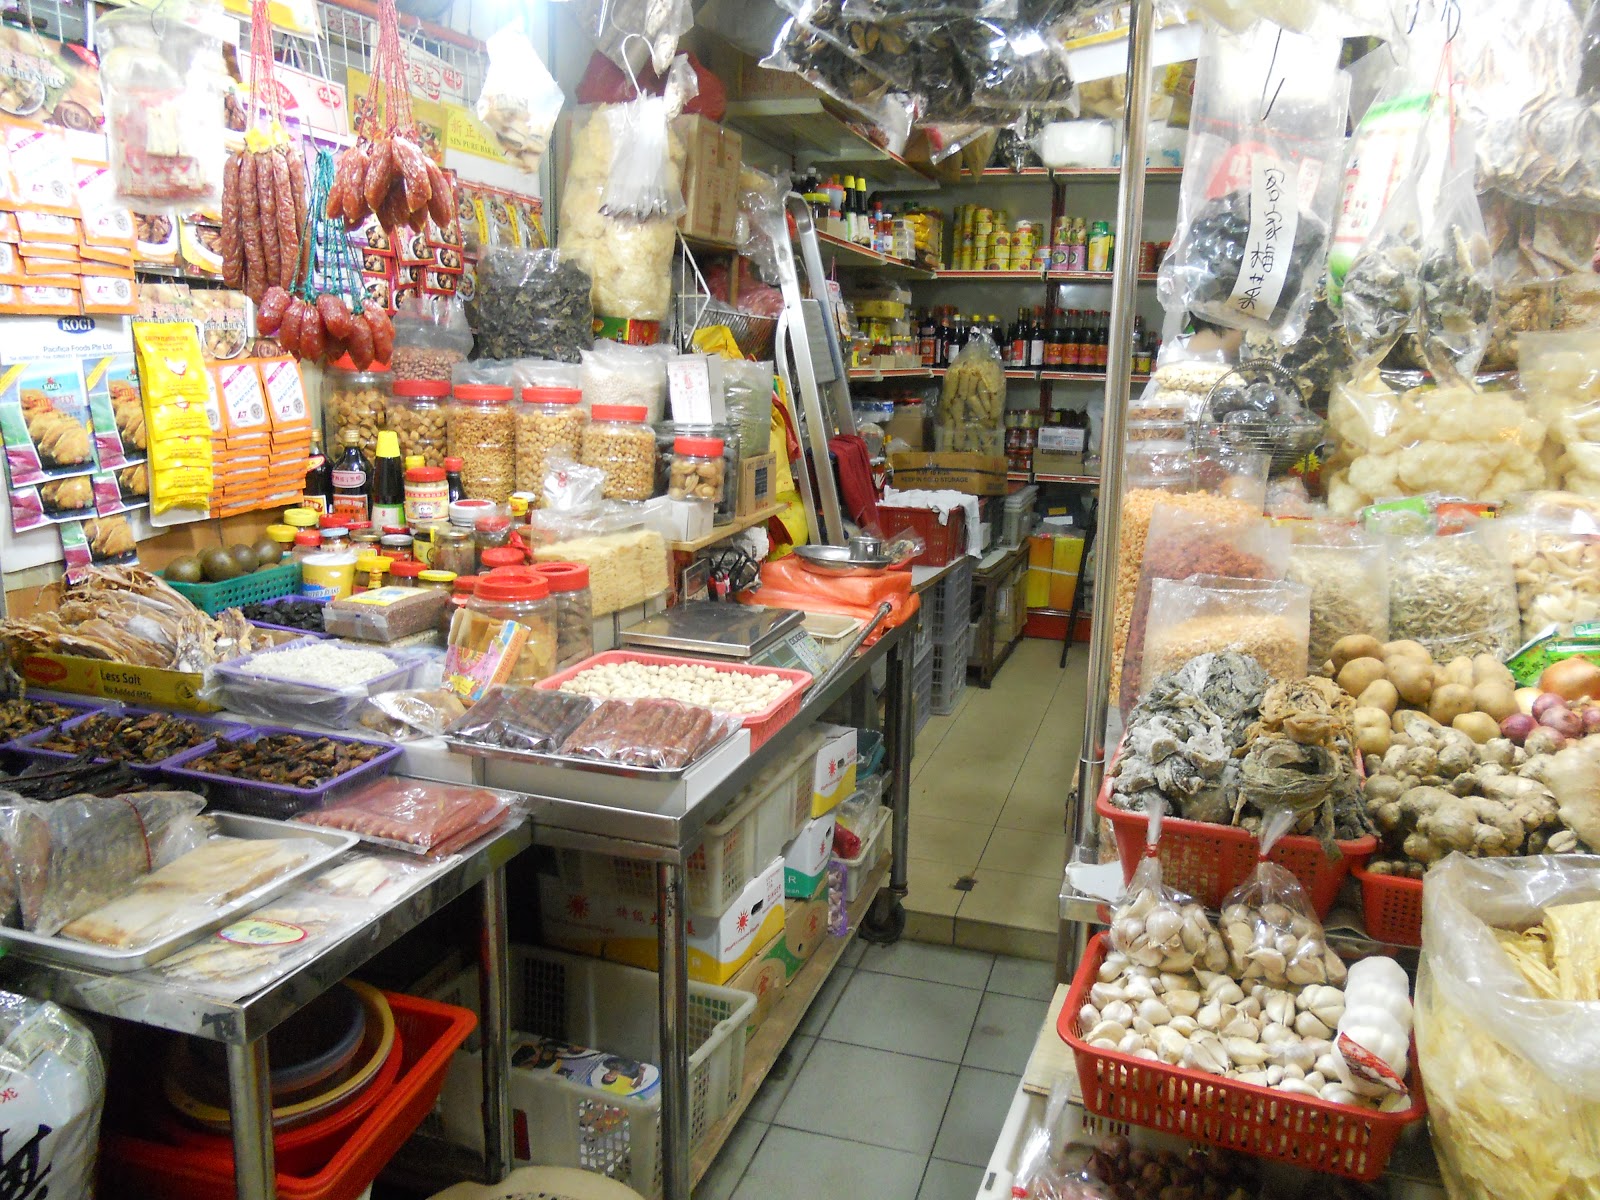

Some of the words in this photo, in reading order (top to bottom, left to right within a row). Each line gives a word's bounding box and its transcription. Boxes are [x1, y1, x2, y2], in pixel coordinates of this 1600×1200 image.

[463, 141, 479, 150] PURE
[62, 319, 92, 331] KOGI
[43, 345, 70, 353] Pacifica
[71, 344, 91, 352] Foods
[92, 343, 102, 351] Pte
[501, 653, 513, 672] BEAN
[511, 633, 523, 651] CURD
[100, 669, 121, 683] Less
[122, 672, 141, 686] Salt
[114, 687, 135, 698] Added
